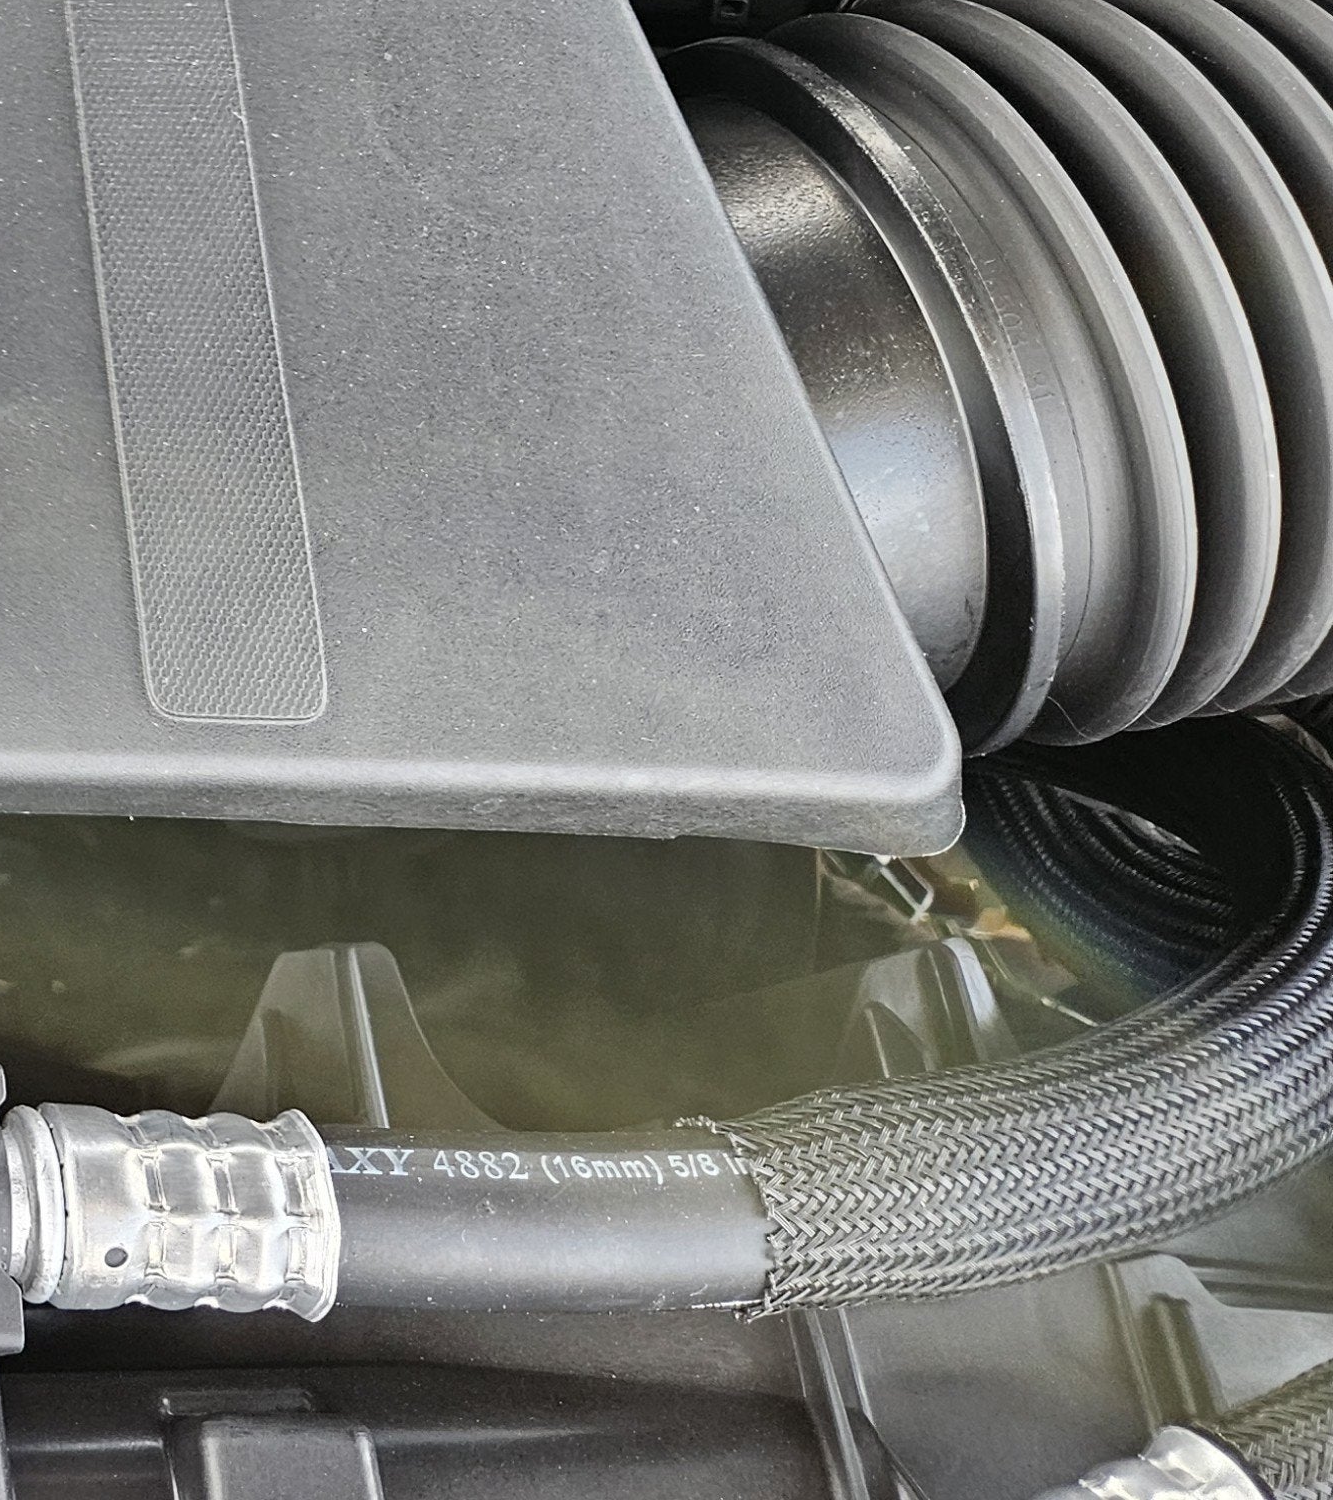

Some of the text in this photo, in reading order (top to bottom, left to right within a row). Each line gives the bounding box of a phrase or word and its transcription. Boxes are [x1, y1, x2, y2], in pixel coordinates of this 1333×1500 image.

[326, 1146, 415, 1176] AXY
[433, 1150, 530, 1180] 4882
[540, 1153, 664, 1185] (16mm)
[667, 1152, 721, 1178] 5/8
